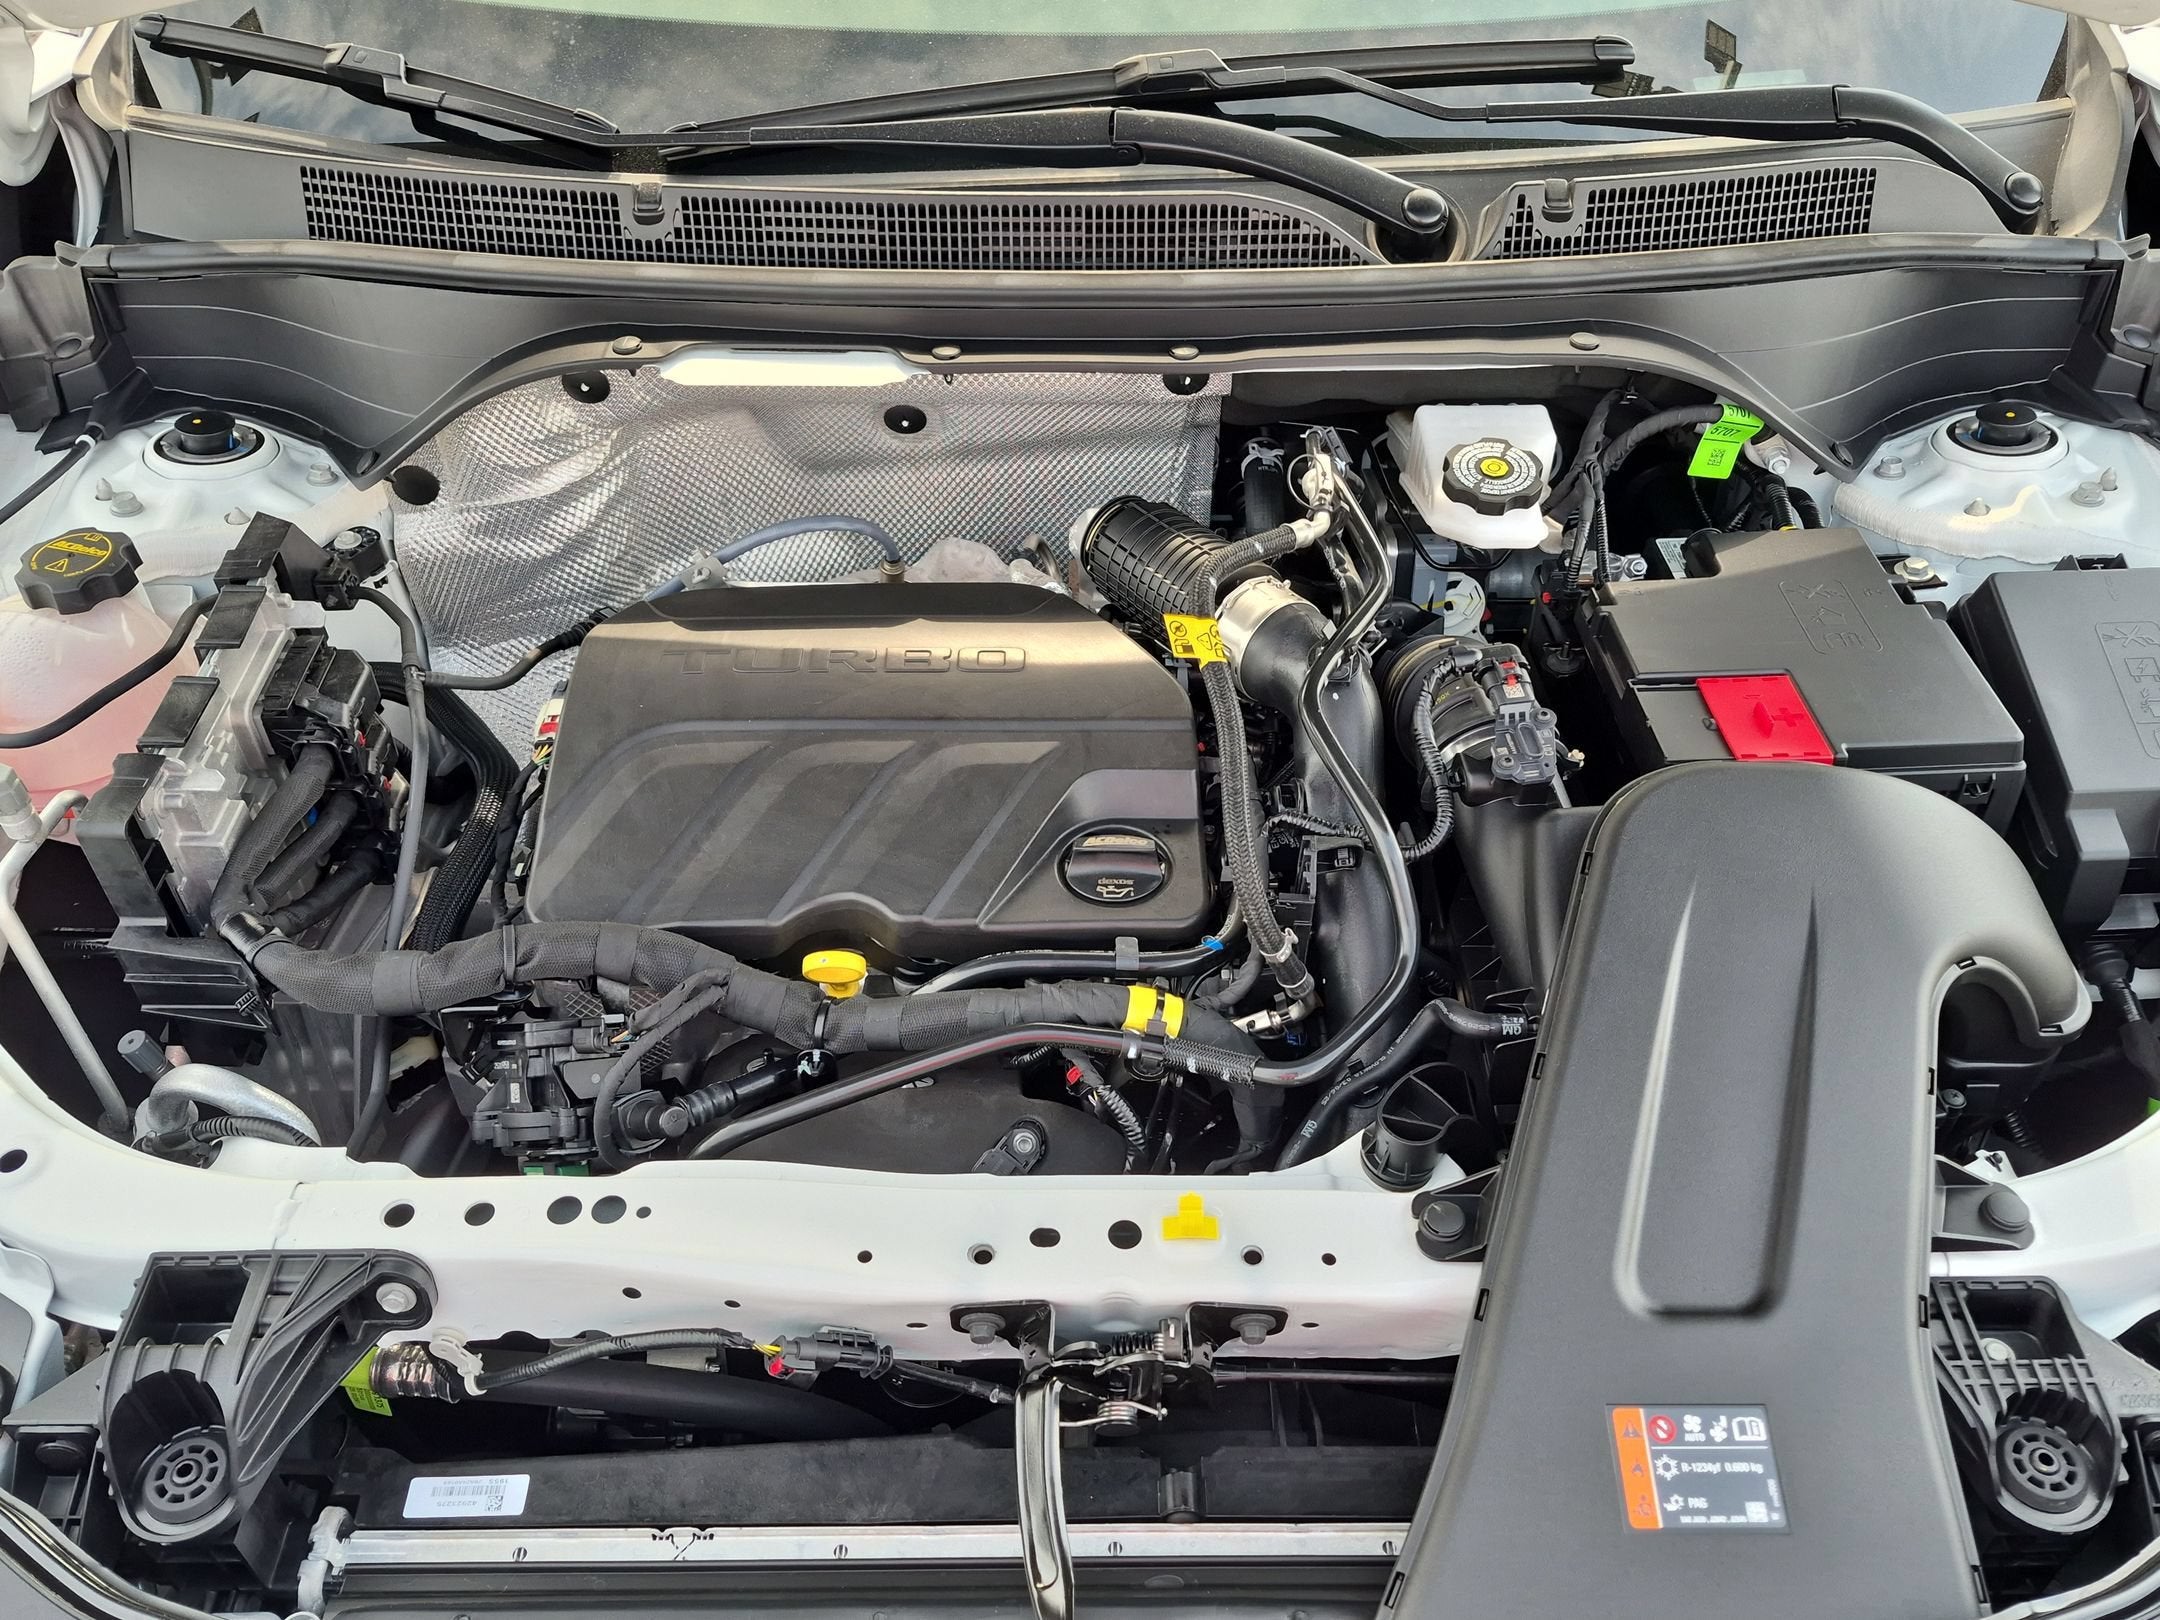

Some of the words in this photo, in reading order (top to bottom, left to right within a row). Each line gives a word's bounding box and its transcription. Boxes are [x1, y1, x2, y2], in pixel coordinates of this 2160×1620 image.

[1710, 426, 1742, 438] 5707
[660, 646, 1027, 675] TURBO
[1502, 1023, 1522, 1036] GM
[1300, 1119, 1318, 1139] GM
[1750, 1461, 1764, 1474] kg
